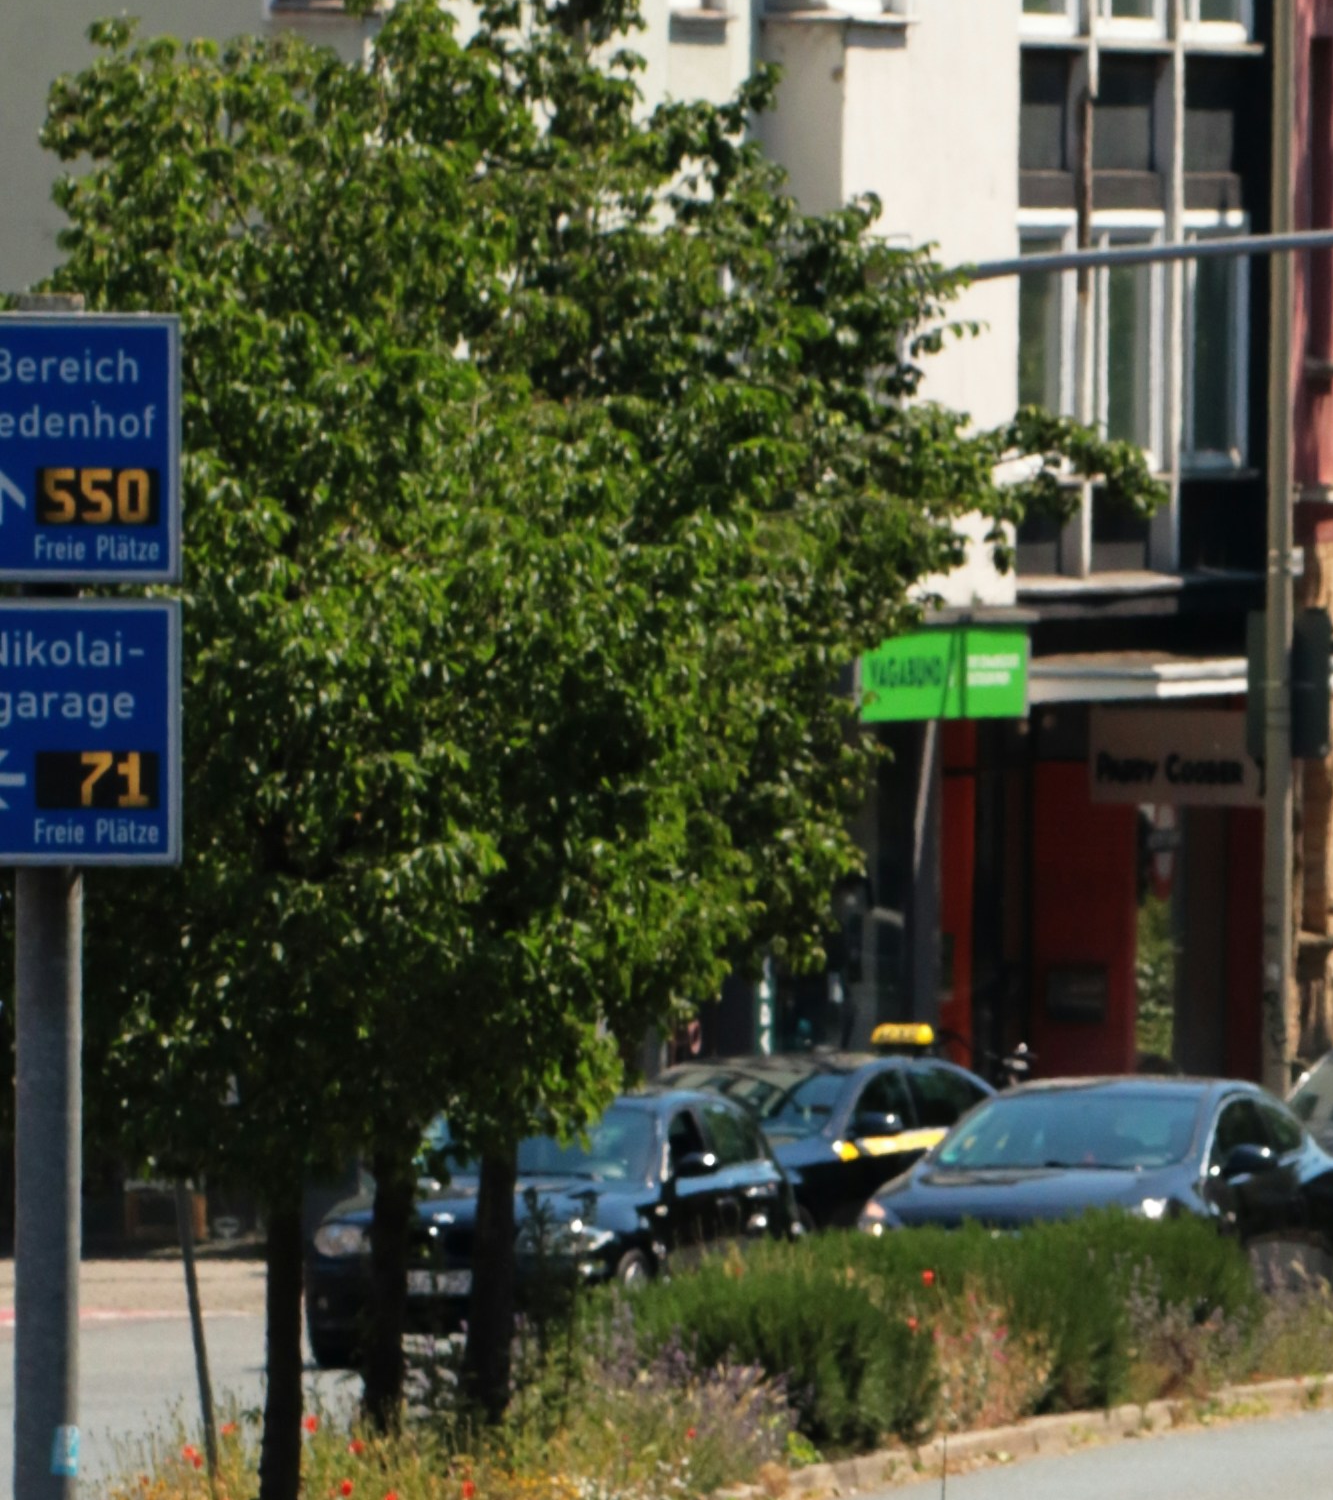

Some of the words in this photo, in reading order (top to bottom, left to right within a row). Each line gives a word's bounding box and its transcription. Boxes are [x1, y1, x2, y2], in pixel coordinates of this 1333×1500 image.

[0, 348, 139, 383] Bereich
[44, 467, 150, 524] 550
[35, 533, 86, 560] Freie
[97, 534, 160, 561] Plätze
[0, 692, 136, 729] garage
[81, 752, 149, 808] 71
[35, 818, 86, 843] Freie
[97, 818, 160, 844] Plätze
